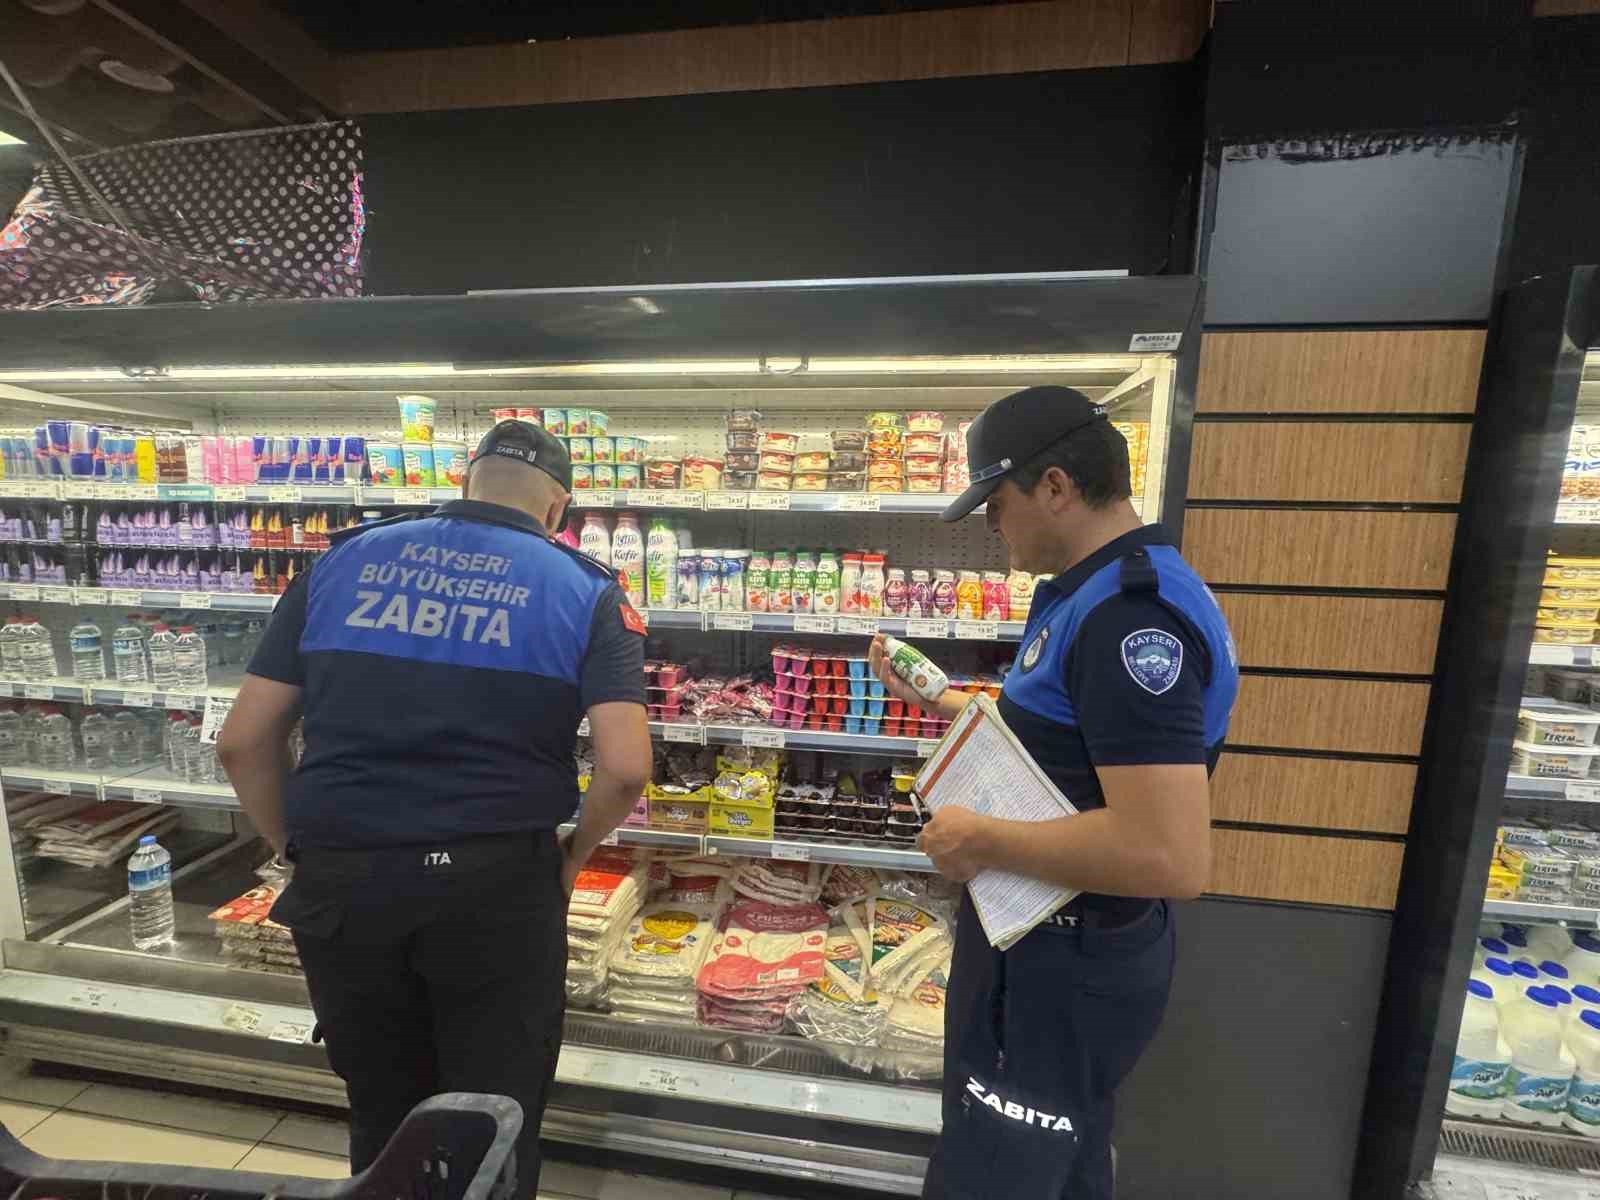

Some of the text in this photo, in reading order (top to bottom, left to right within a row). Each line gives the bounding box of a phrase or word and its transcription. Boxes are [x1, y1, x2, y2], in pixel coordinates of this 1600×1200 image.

[358, 561, 531, 607] BÜYÜKŞEHİR
[345, 590, 511, 647] ZABITA
[966, 1076, 1073, 1131] ZABITA
